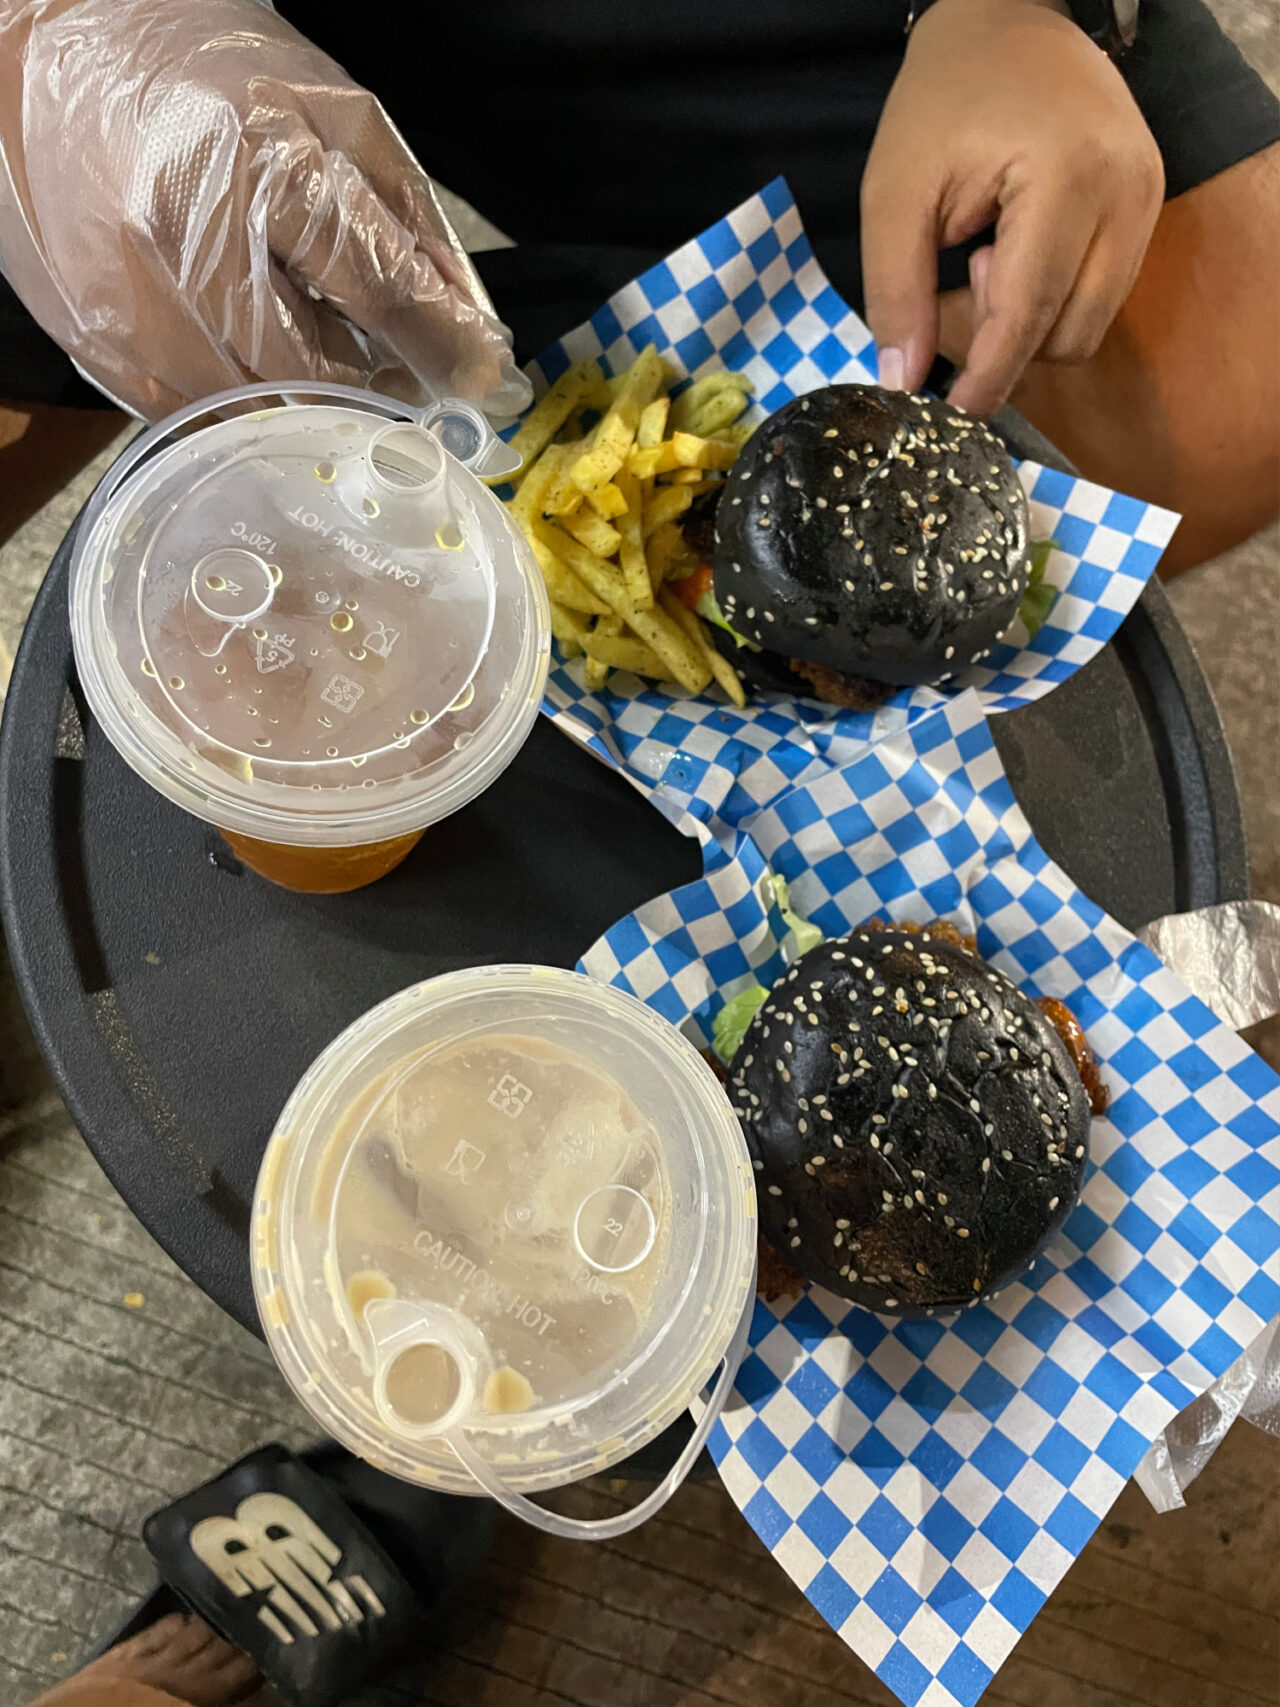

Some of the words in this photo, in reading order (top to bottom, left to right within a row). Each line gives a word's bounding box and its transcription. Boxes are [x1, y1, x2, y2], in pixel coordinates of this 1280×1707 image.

[287, 505, 334, 538] HOT
[603, 1217, 624, 1237] 22
[506, 1295, 557, 1336] HOT
